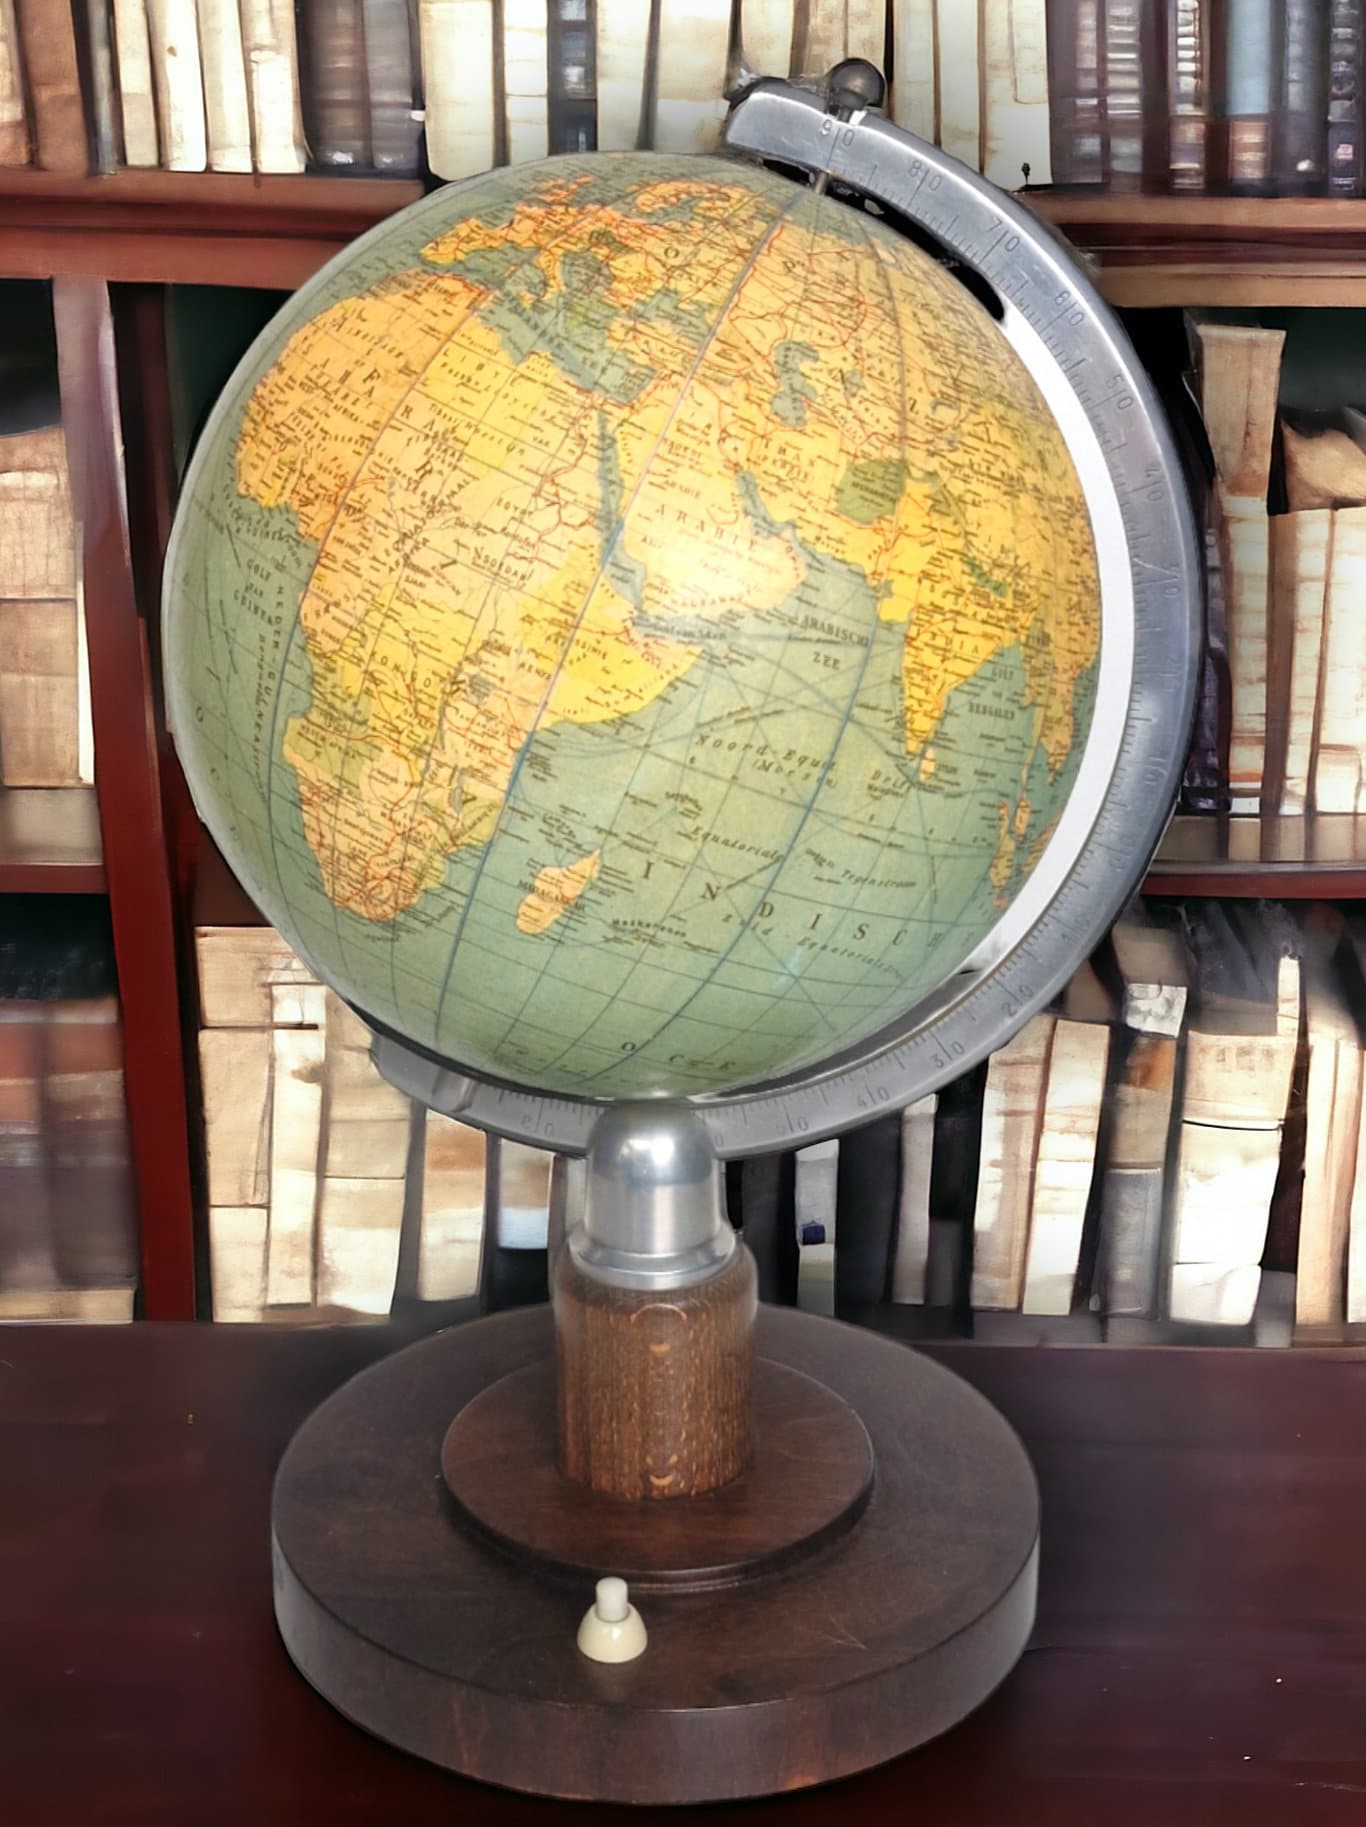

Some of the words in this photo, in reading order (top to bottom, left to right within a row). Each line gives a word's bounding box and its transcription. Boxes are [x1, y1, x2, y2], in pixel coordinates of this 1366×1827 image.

[819, 118, 856, 148] 90
[907, 159, 942, 192] 80
[985, 217, 1022, 253] 70
[1053, 291, 1086, 328] 60
[1106, 374, 1136, 411] 50
[812, 651, 841, 671] ZEE
[1001, 985, 1034, 1017] 20
[933, 1040, 965, 1069] 30
[856, 1087, 890, 1108] 40
